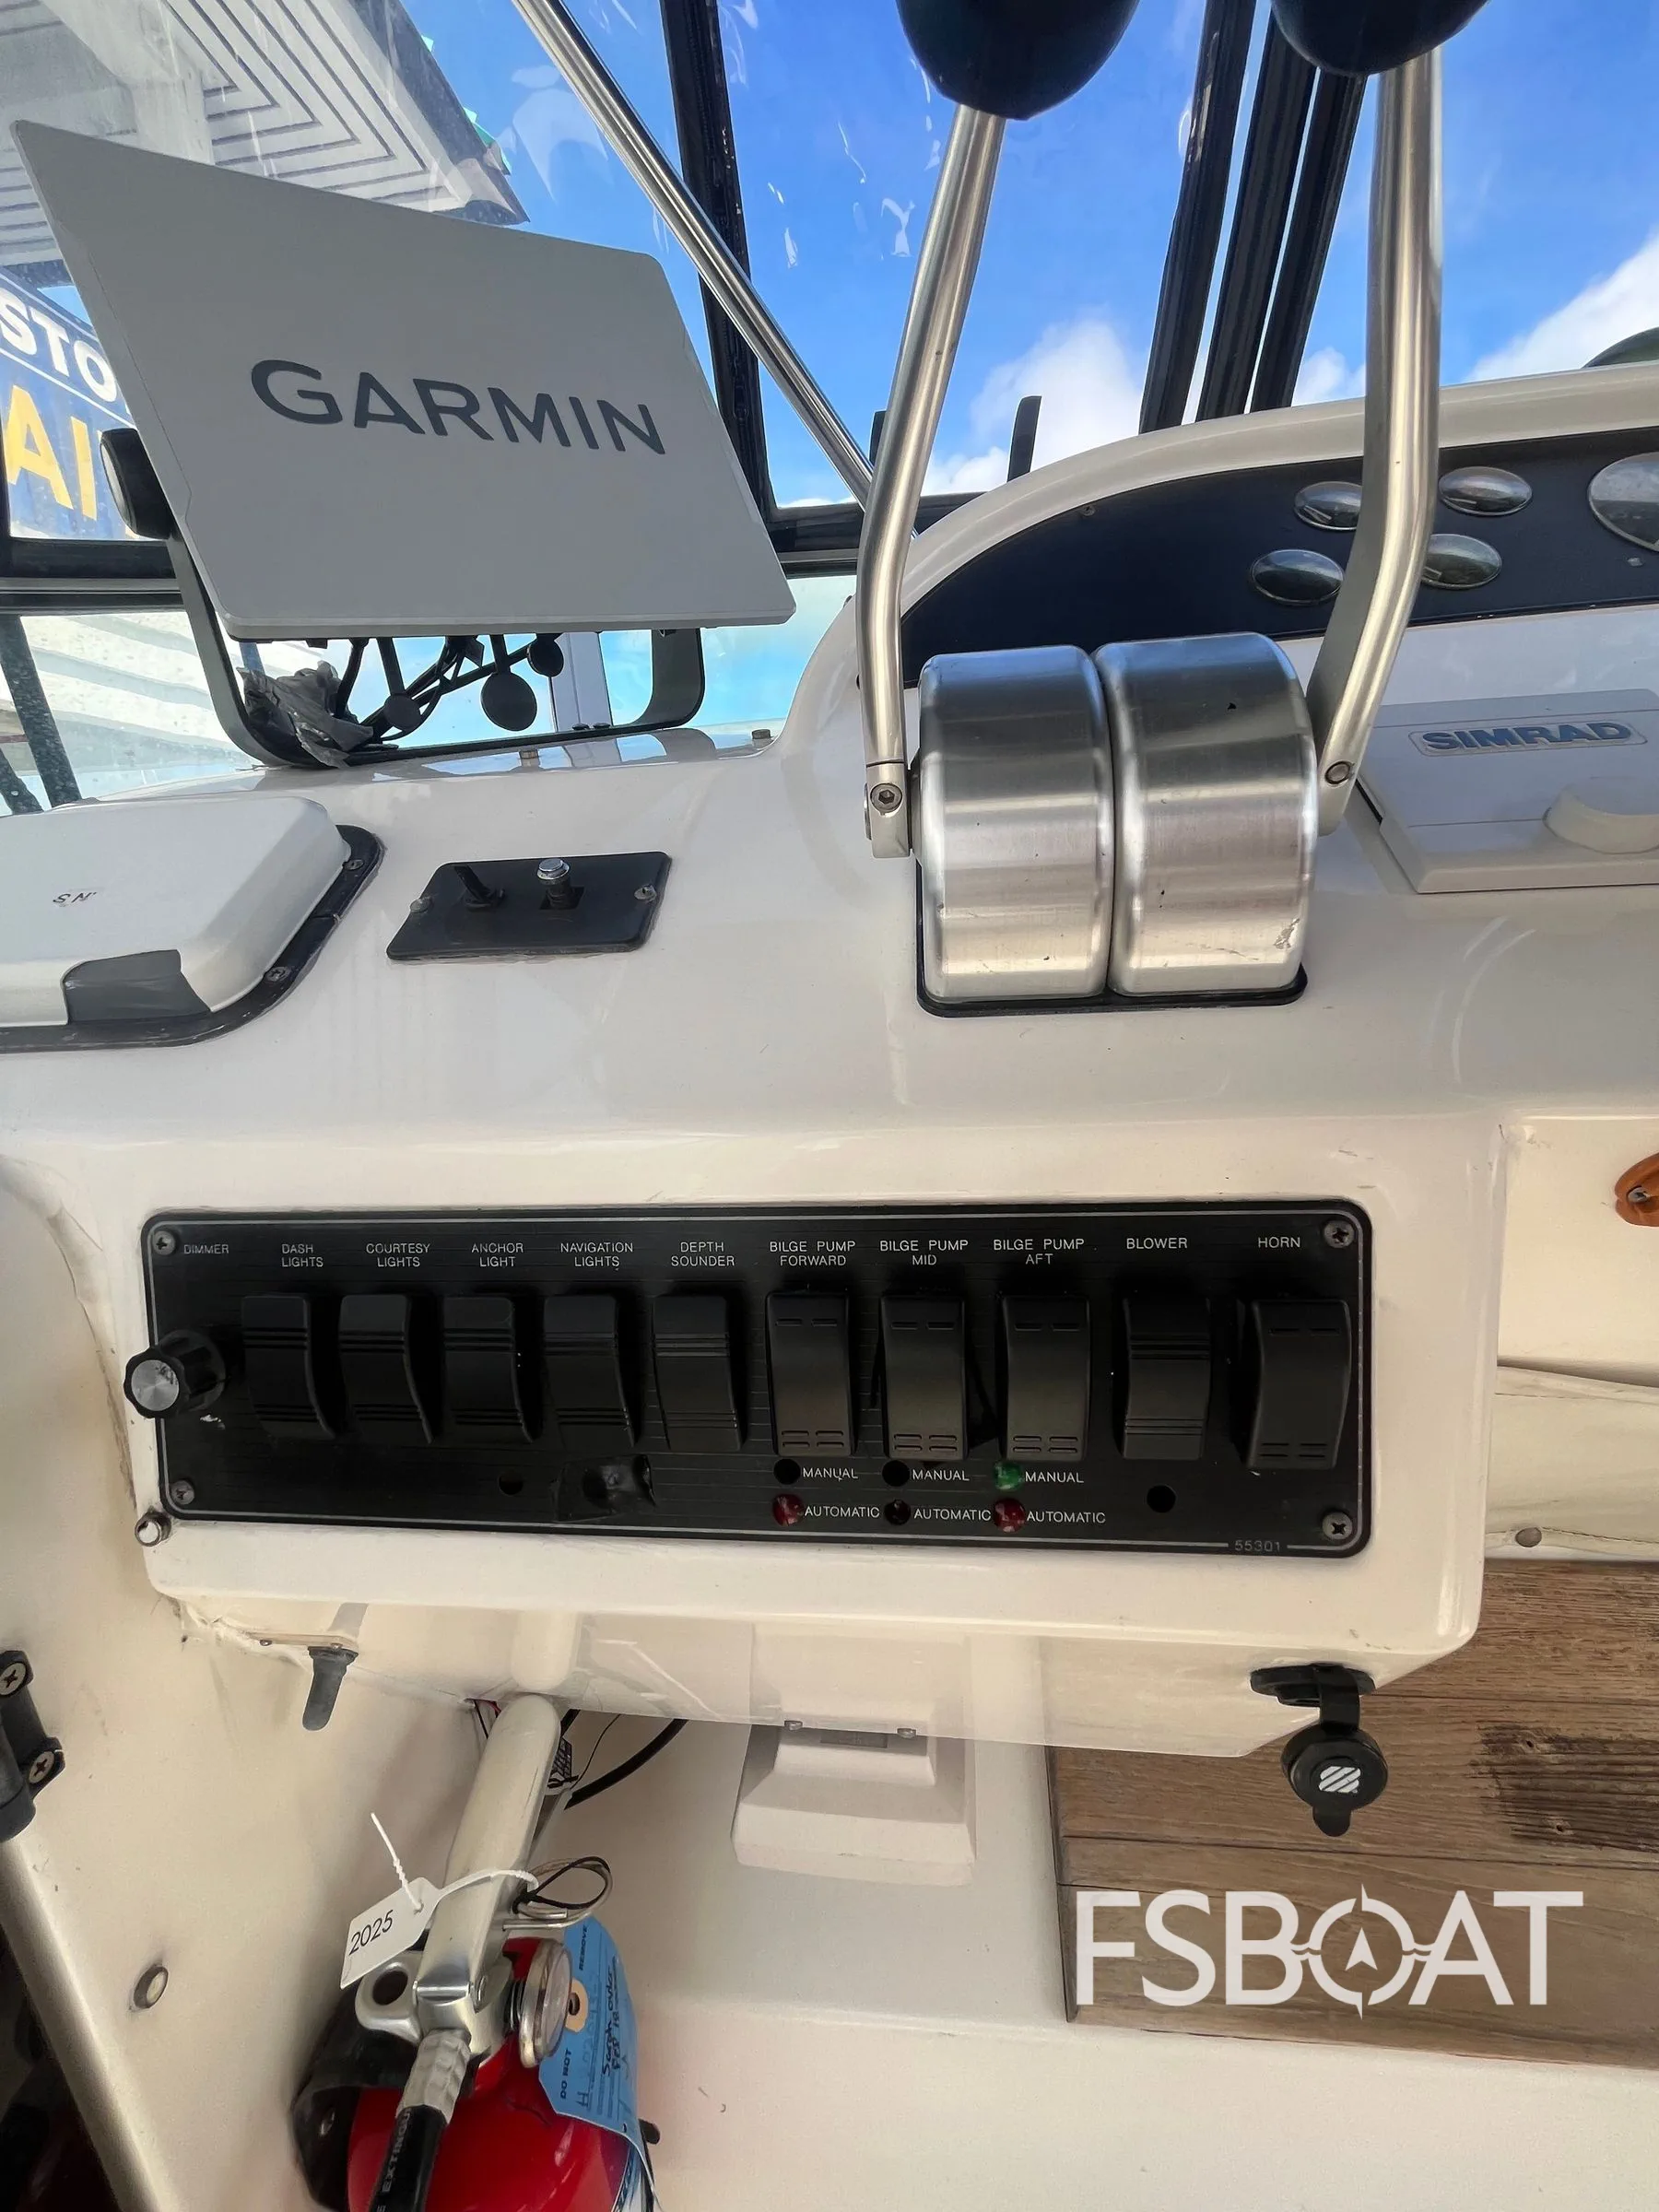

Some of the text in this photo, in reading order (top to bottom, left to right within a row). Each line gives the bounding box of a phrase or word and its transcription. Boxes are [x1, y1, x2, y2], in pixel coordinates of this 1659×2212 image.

[0, 287, 131, 415] STO
[251, 359, 666, 455] GARMIN
[1421, 722, 1632, 750] SIMRAD
[183, 1243, 229, 1254] DIMMER
[281, 1243, 314, 1254] DASH
[366, 1242, 430, 1254] COURTESY
[471, 1242, 524, 1253] ANCHOR
[560, 1241, 633, 1253] NAVIGATION
[680, 1241, 724, 1253] DEPTH
[770, 1241, 856, 1253] BILGE PUMP
[879, 1239, 969, 1252] BILGE PUMP
[993, 1238, 1085, 1251] BILGE PUMP
[1126, 1237, 1188, 1250] BLOWER
[1258, 1236, 1300, 1249] HORN
[281, 1256, 324, 1267] LIGHTS
[377, 1256, 420, 1267] LIGHTS
[479, 1255, 516, 1267] LIGHT
[574, 1255, 620, 1267] LIGHTS
[671, 1255, 735, 1266] SOUNDER
[780, 1254, 847, 1266] FORWARD
[912, 1253, 937, 1265] MID
[1025, 1253, 1053, 1265] AFT
[803, 1467, 858, 1481] MANUAL
[912, 1468, 970, 1481] MANUAL
[1025, 1471, 1085, 1483] MANUAL
[804, 1505, 880, 1518] AUTOMATIC
[913, 1508, 992, 1522] AUTOMATIC
[1026, 1511, 1106, 1524] AUTOMATIC
[1234, 1539, 1280, 1552] 55301
[347, 1909, 394, 1956] 2025
[578, 1924, 588, 1971] REMOVE
